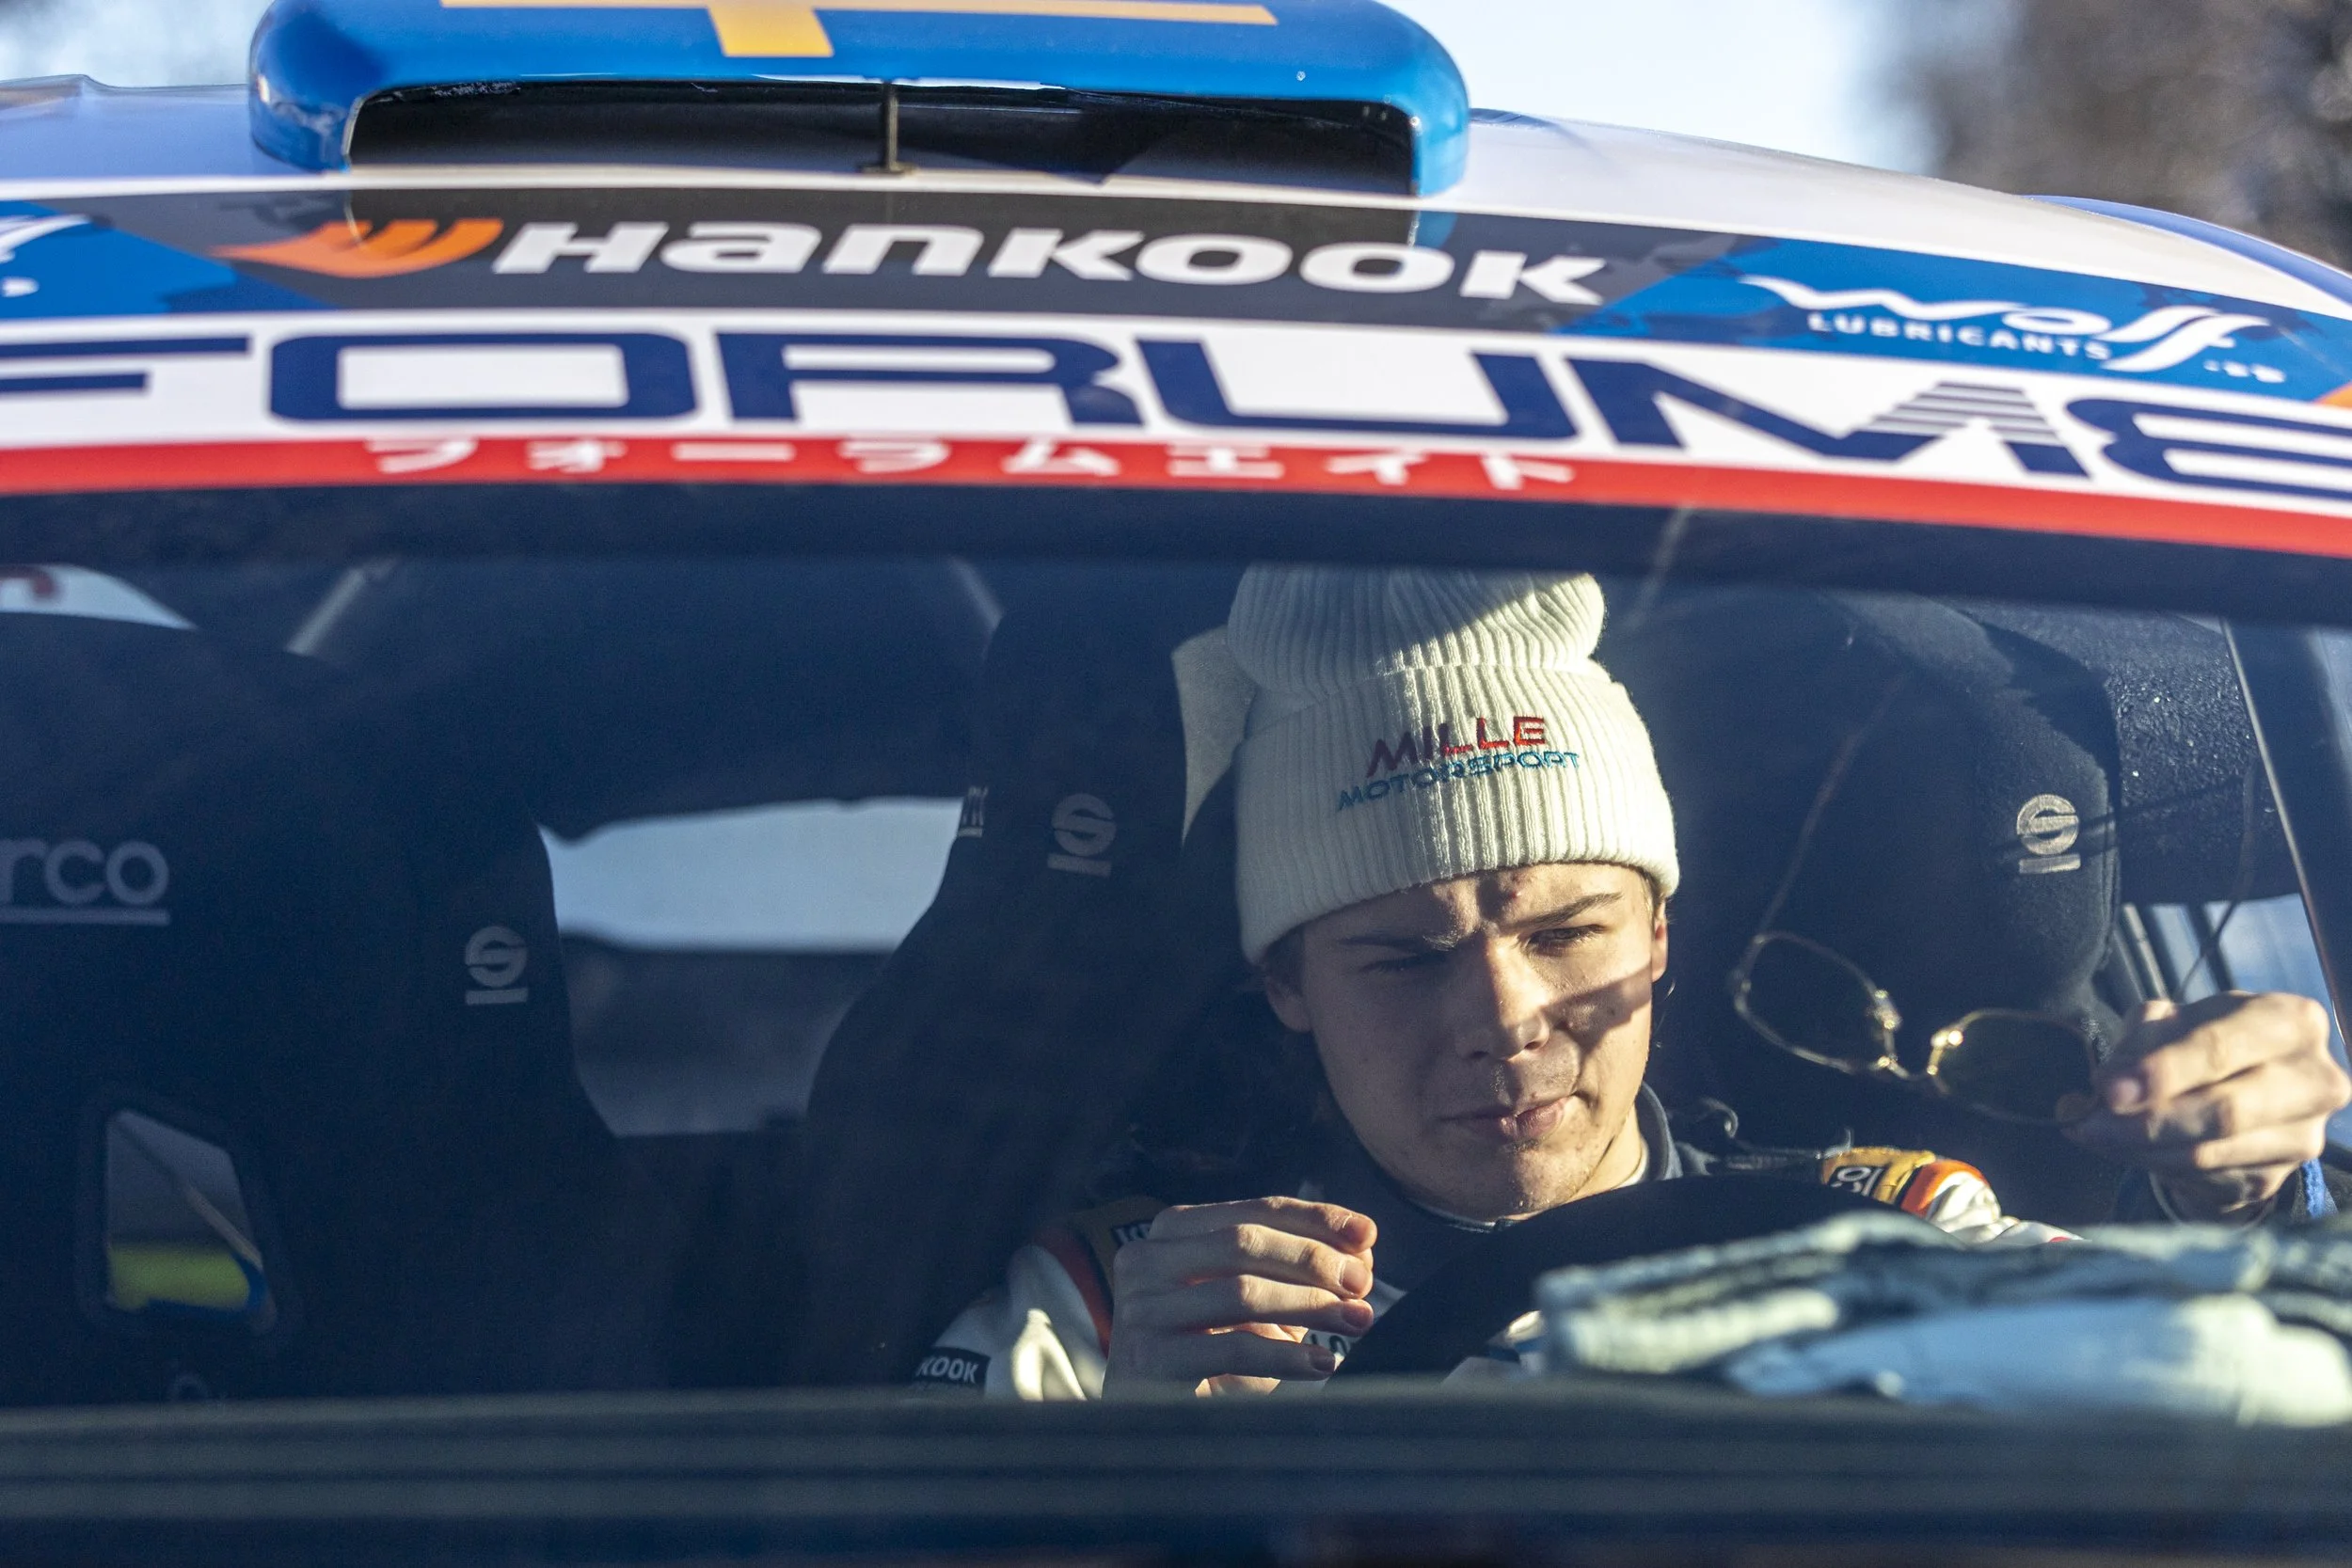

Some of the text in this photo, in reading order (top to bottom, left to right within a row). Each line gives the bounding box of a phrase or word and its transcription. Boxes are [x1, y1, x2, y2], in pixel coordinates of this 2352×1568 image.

[1806, 310, 2112, 360] LUBRICANTS
[1366, 715, 1546, 779] MILLE
[1337, 751, 1581, 812] MOTORSPORT
